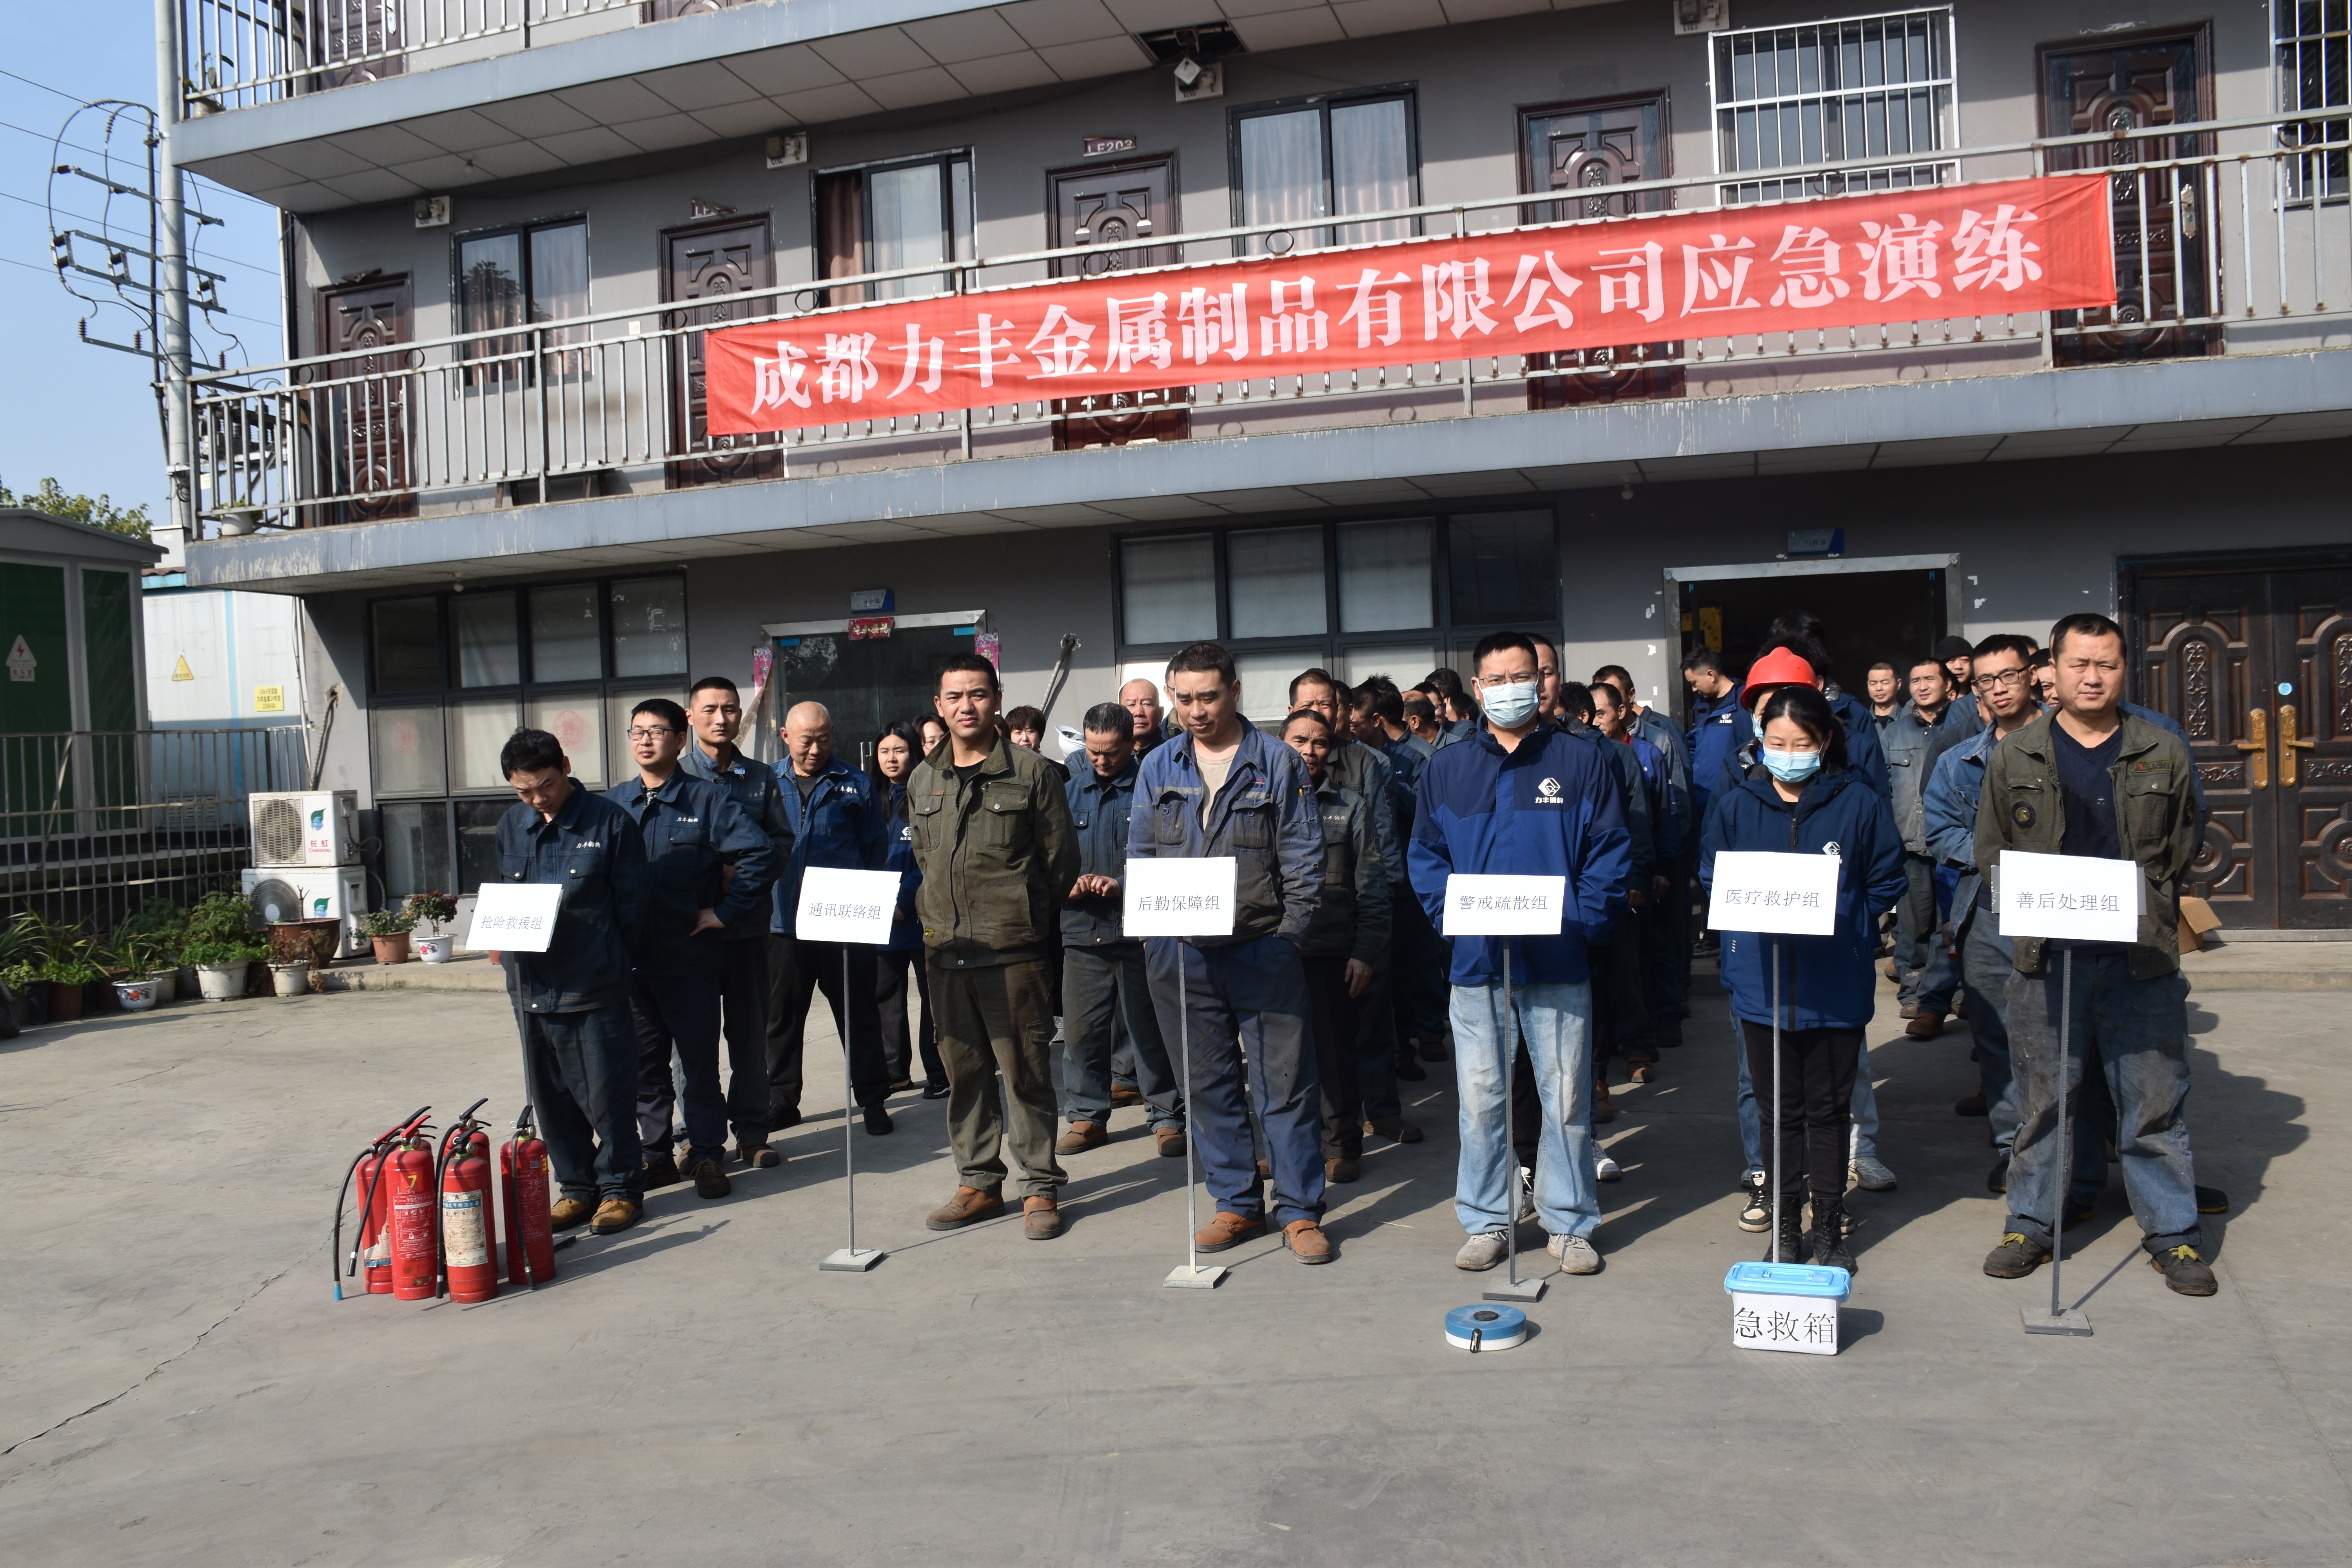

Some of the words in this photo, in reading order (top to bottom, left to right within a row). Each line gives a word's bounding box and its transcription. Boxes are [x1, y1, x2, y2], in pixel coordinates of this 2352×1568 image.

[751, 204, 2042, 416] 成都力丰金属制品有限公司应急演练
[1138, 895, 1220, 911] 后勤保障组
[1459, 895, 1547, 910] 警戒疏散组
[1726, 889, 1819, 907] 医疗救护组
[2016, 891, 2120, 911] 善后处理组
[809, 902, 881, 919] 通讯联络组
[480, 916, 543, 929] 抢险救援组
[407, 1175, 417, 1189] 7
[1734, 1307, 1835, 1344] 急救箱
